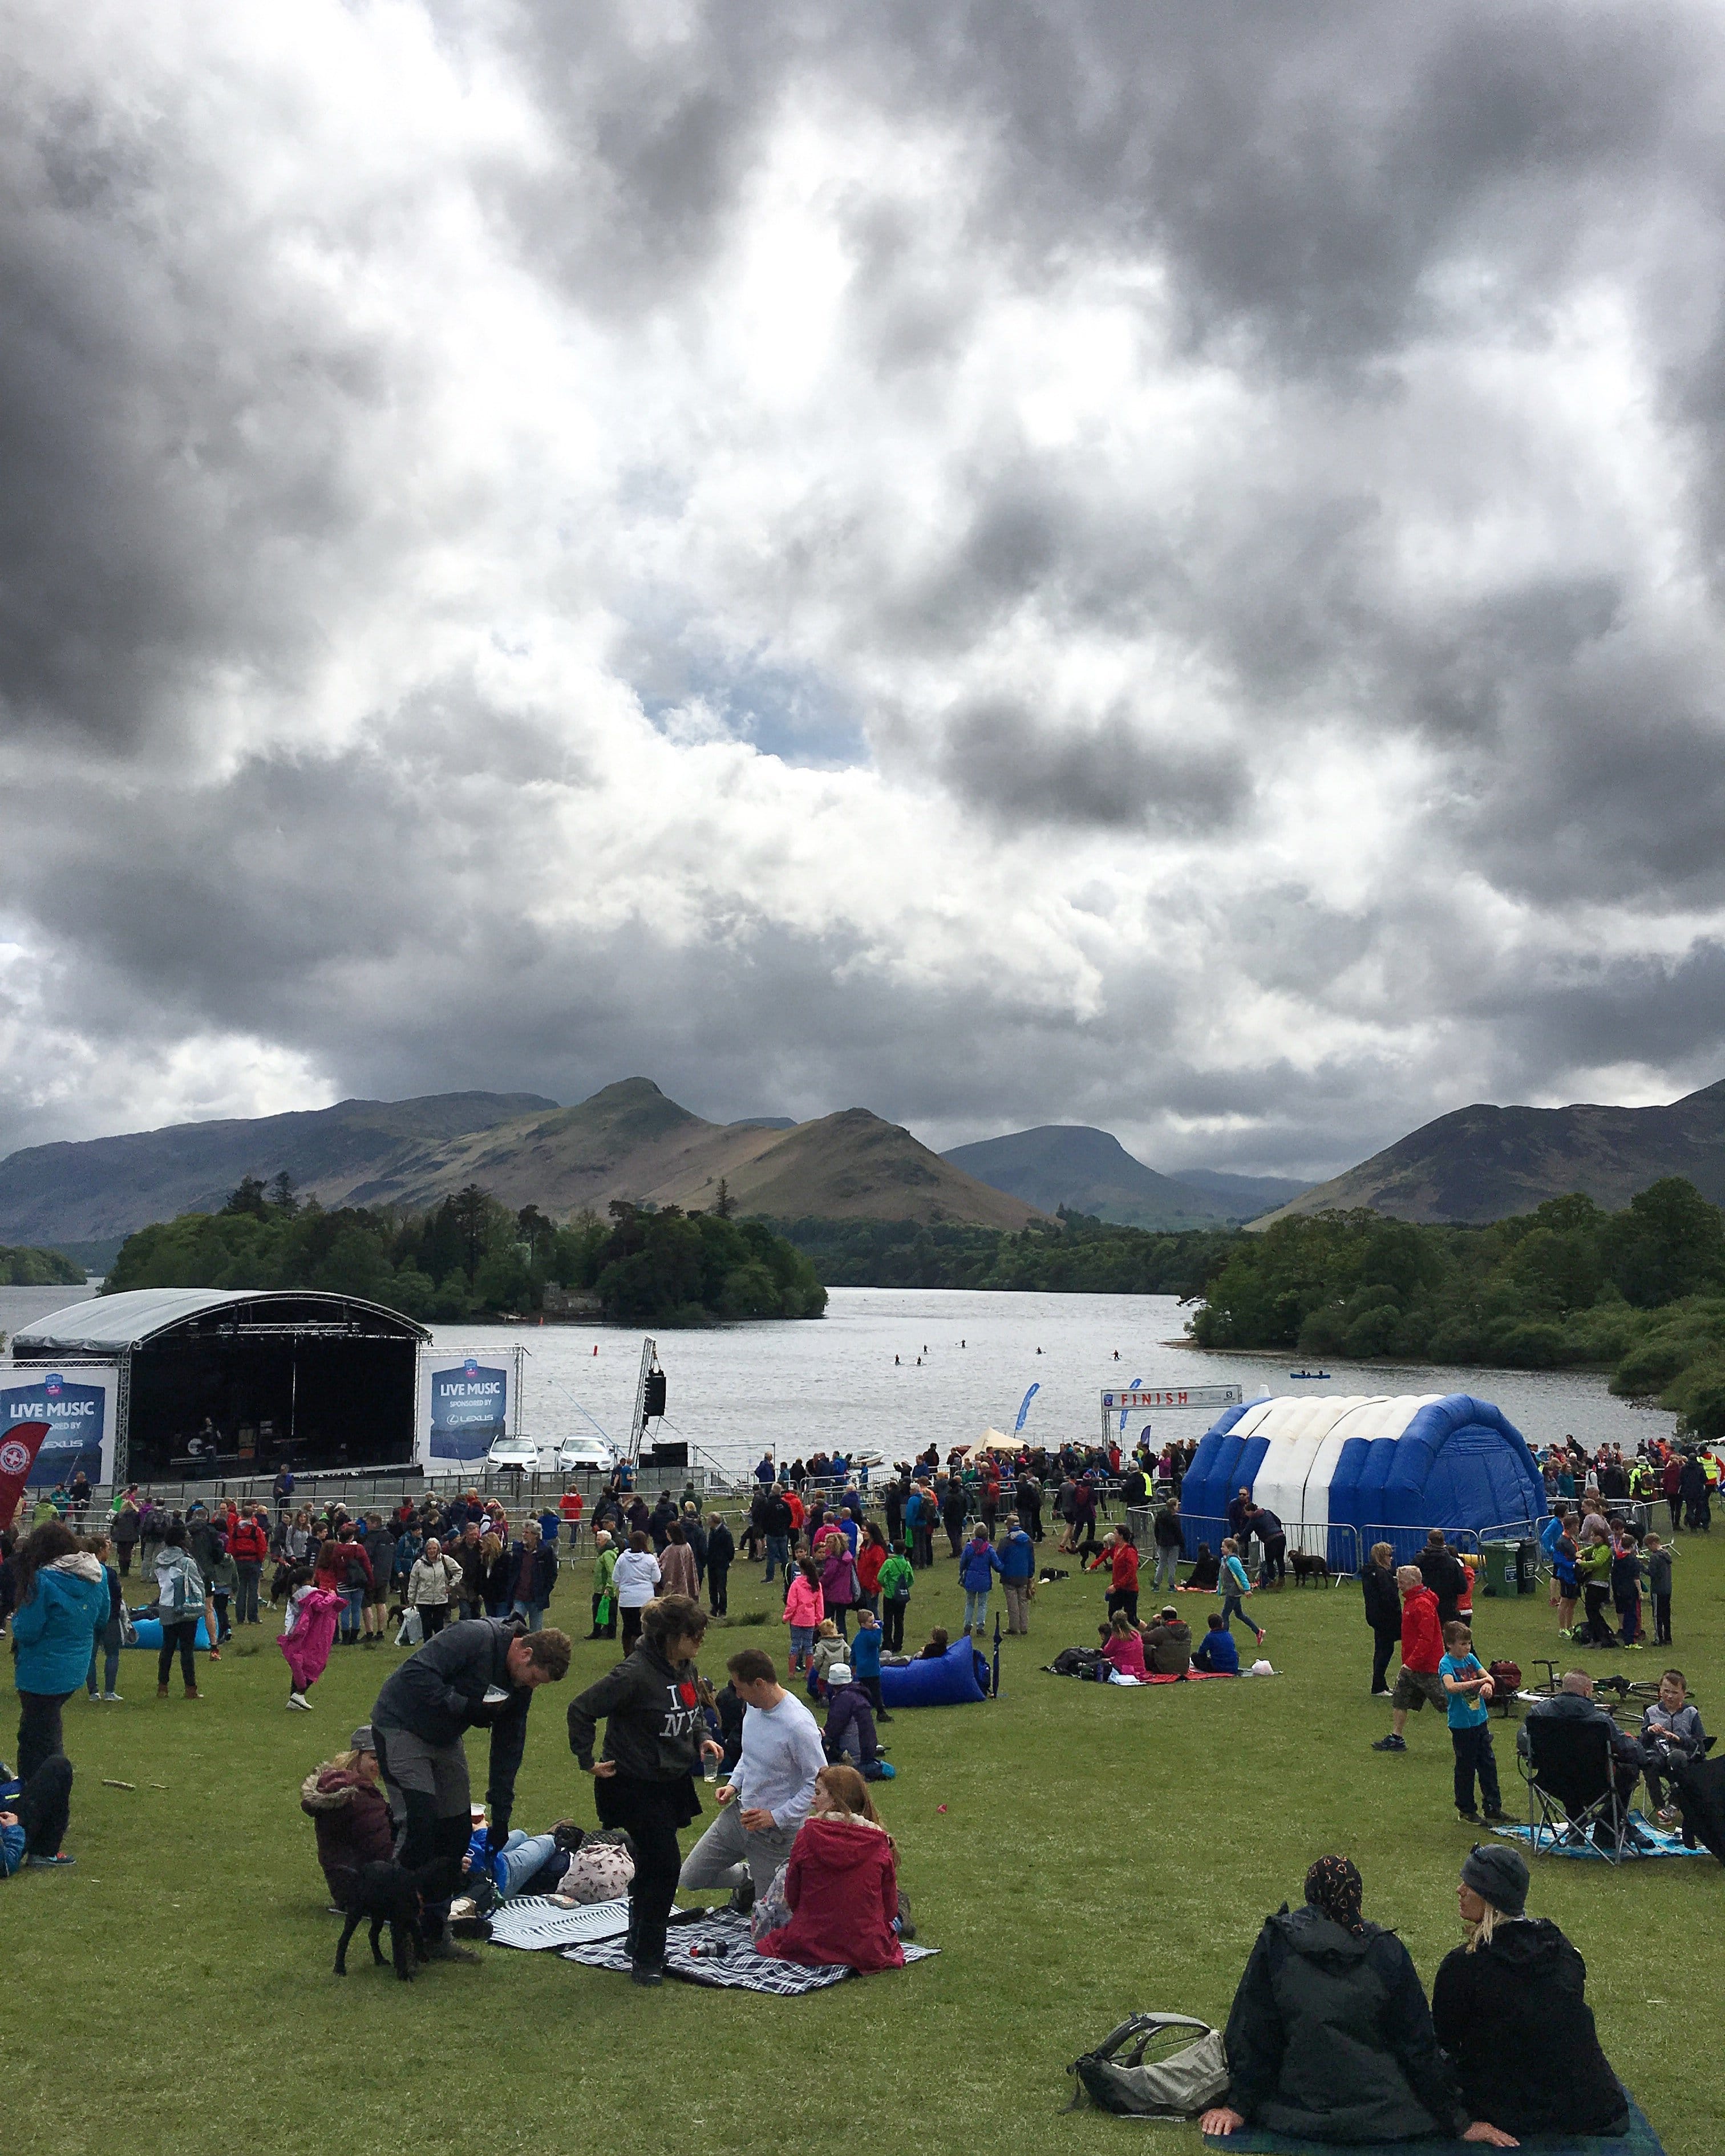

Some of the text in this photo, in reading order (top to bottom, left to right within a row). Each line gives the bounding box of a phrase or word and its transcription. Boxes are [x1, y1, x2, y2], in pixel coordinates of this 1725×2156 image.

[440, 1382, 500, 1396] LIVE MUSIC
[1121, 1392, 1188, 1406] FINISH
[10, 1401, 95, 1418] LIVE MUSIC
[667, 1684, 681, 1710] I
[659, 1706, 699, 1737] NY
